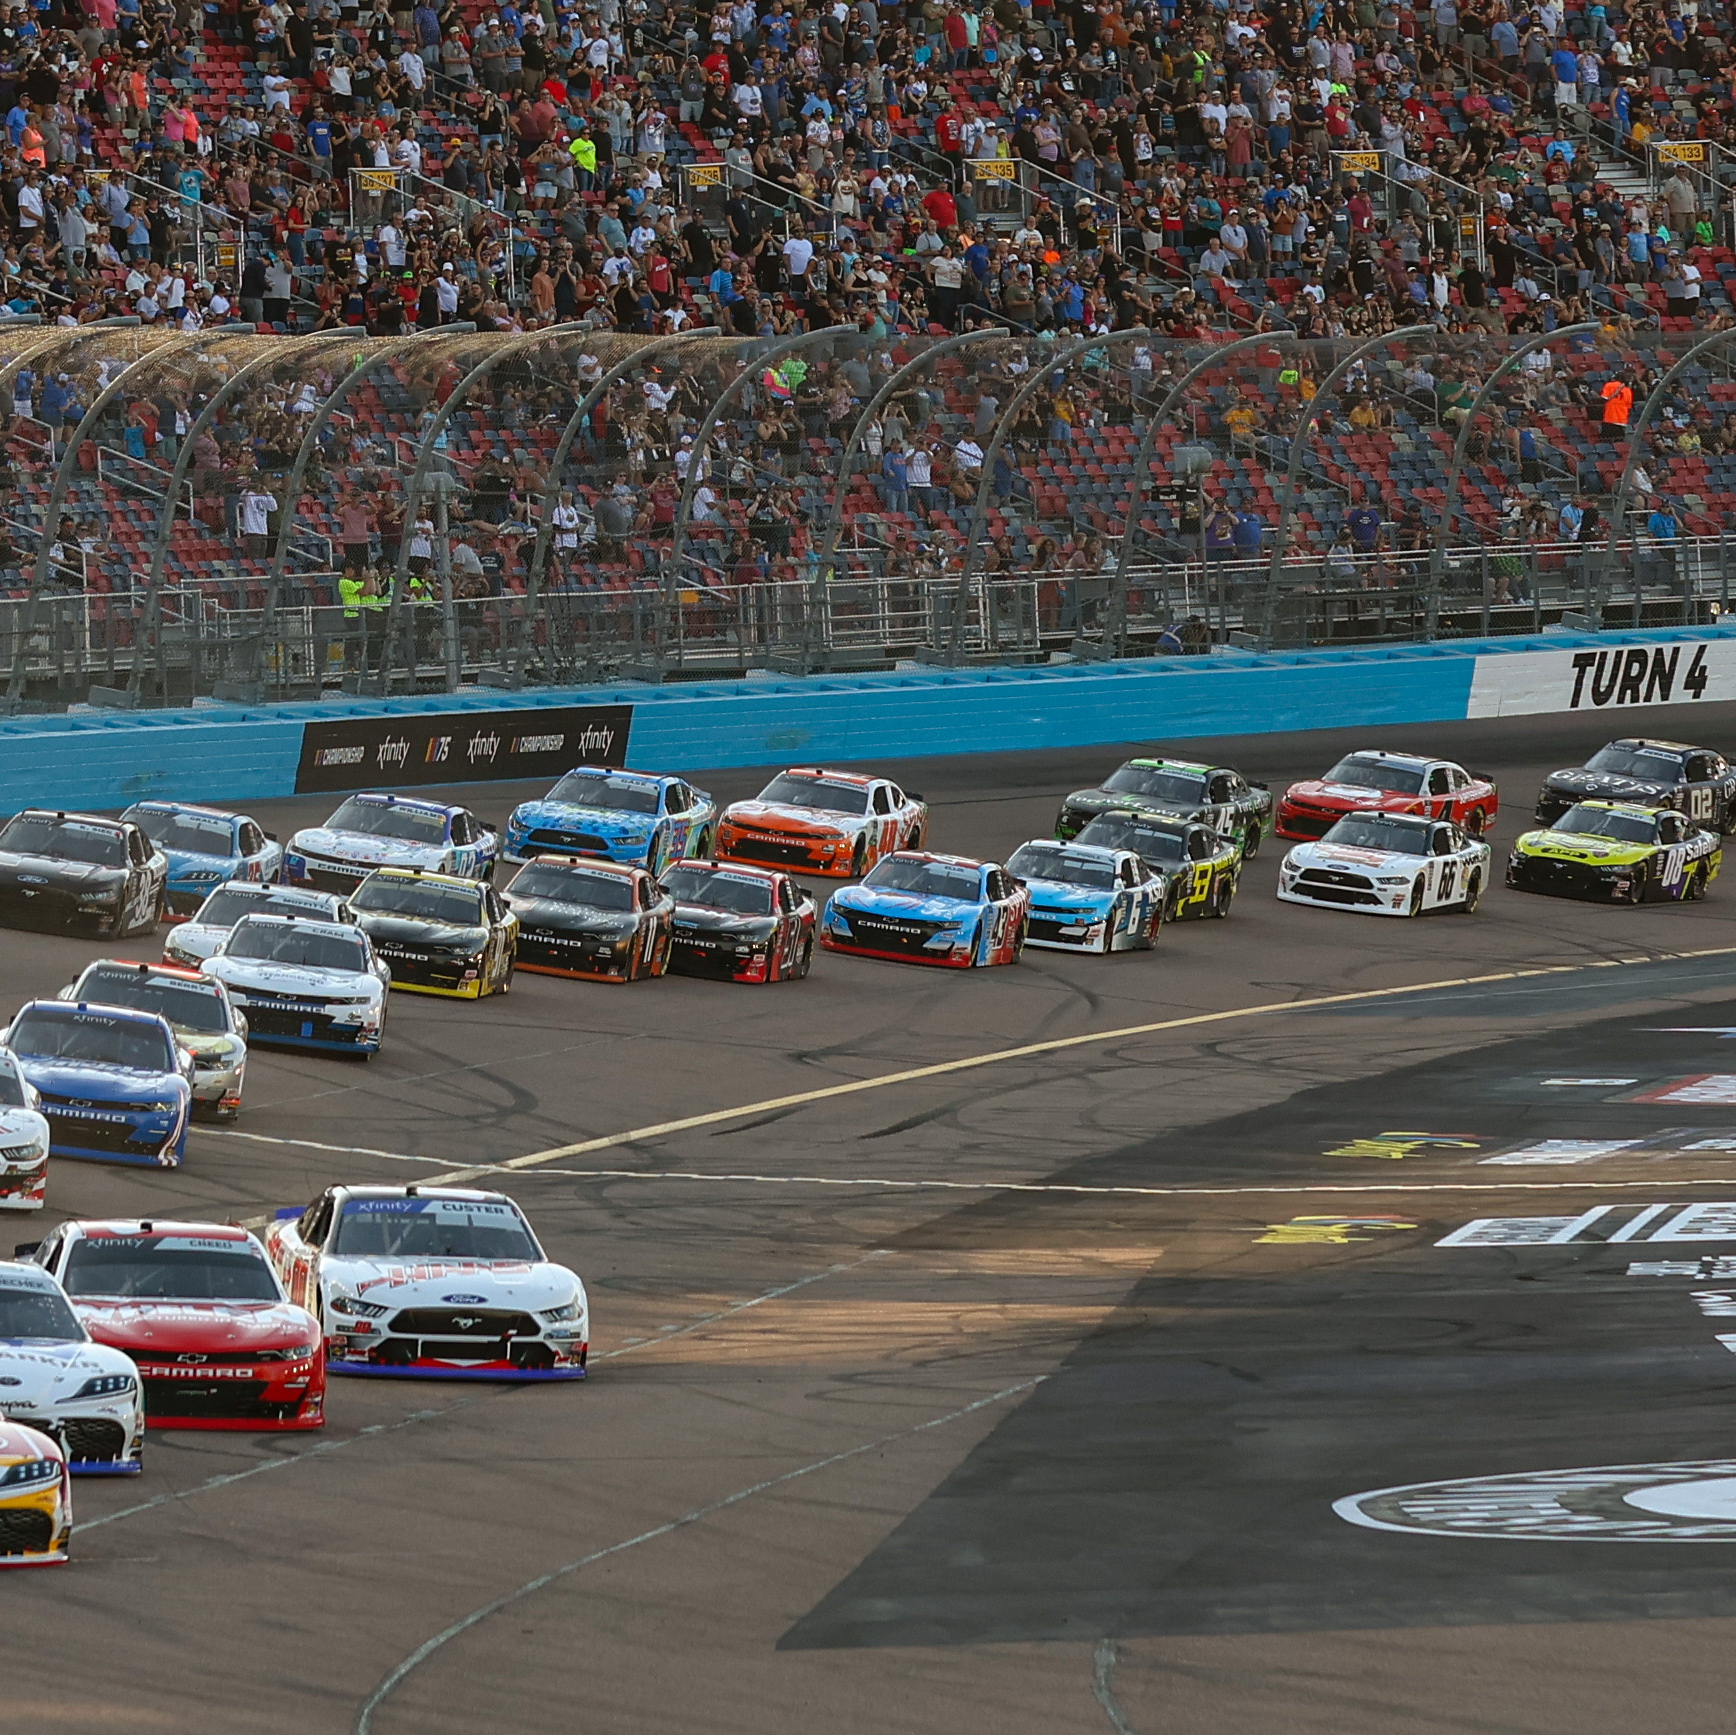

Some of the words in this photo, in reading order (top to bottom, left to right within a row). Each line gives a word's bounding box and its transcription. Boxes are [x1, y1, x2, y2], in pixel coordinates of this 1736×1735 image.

[1682, 146, 1701, 158] 133
[1569, 646, 1681, 708] TURN
[1683, 644, 1708, 699] 4
[377, 735, 410, 769] xfinity
[435, 736, 452, 763] 75
[467, 729, 501, 763] xfinity
[578, 723, 614, 757] xfinity
[1690, 787, 1713, 820] 02
[746, 833, 806, 846] CAMARO
[1662, 847, 1686, 888] 08
[1437, 861, 1458, 902] 66
[857, 919, 921, 934] CAMARO
[169, 978, 207, 991] BERRY
[73, 1014, 117, 1026] xfinity
[358, 1199, 413, 1212] xfinity
[441, 1200, 506, 1215] CUSTER
[85, 1237, 145, 1248] xfinity
[188, 1238, 233, 1251] CREED
[447, 1294, 487, 1305] Ford
